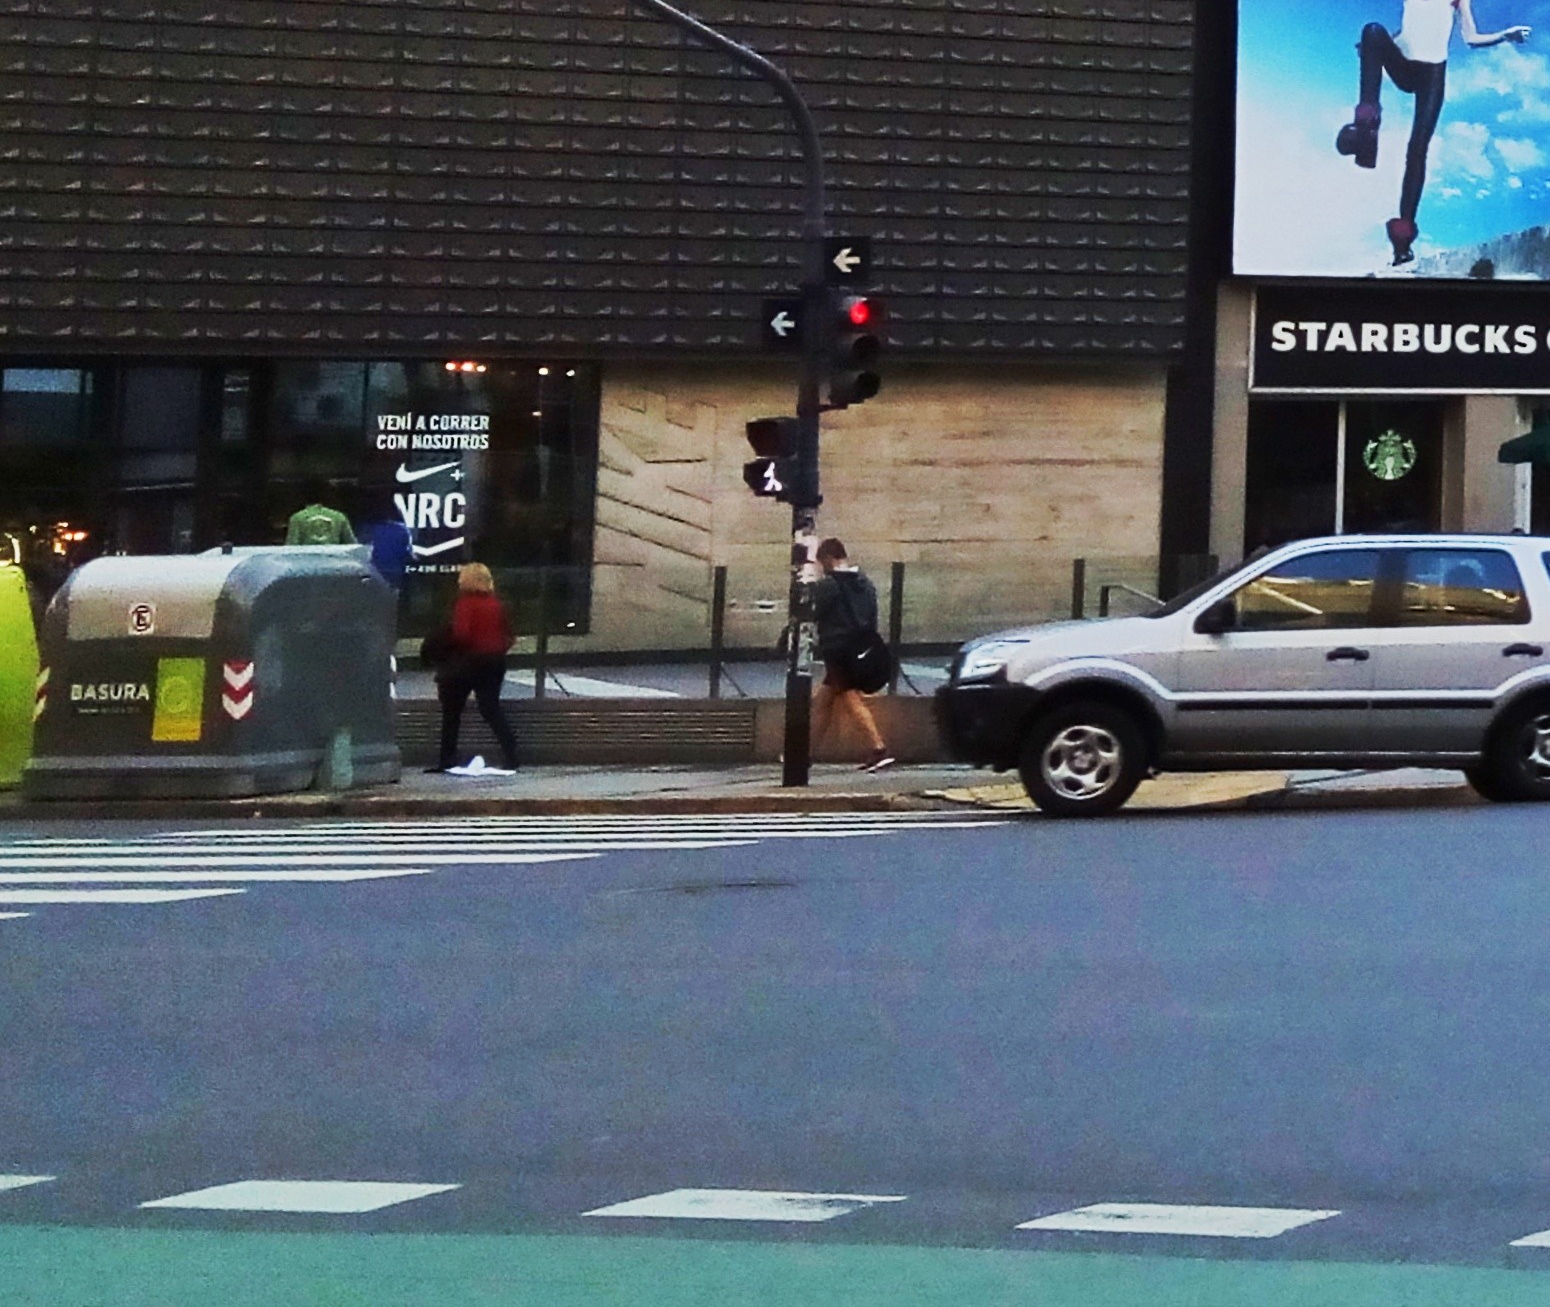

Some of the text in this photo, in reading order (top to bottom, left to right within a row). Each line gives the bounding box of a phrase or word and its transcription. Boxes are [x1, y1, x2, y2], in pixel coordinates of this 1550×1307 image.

[1270, 320, 1538, 355] STARBUCKS
[415, 414, 427, 431] A
[429, 414, 490, 431] CORRER
[376, 433, 490, 450] CON NOSOTROS
[70, 683, 150, 701] BASURA
